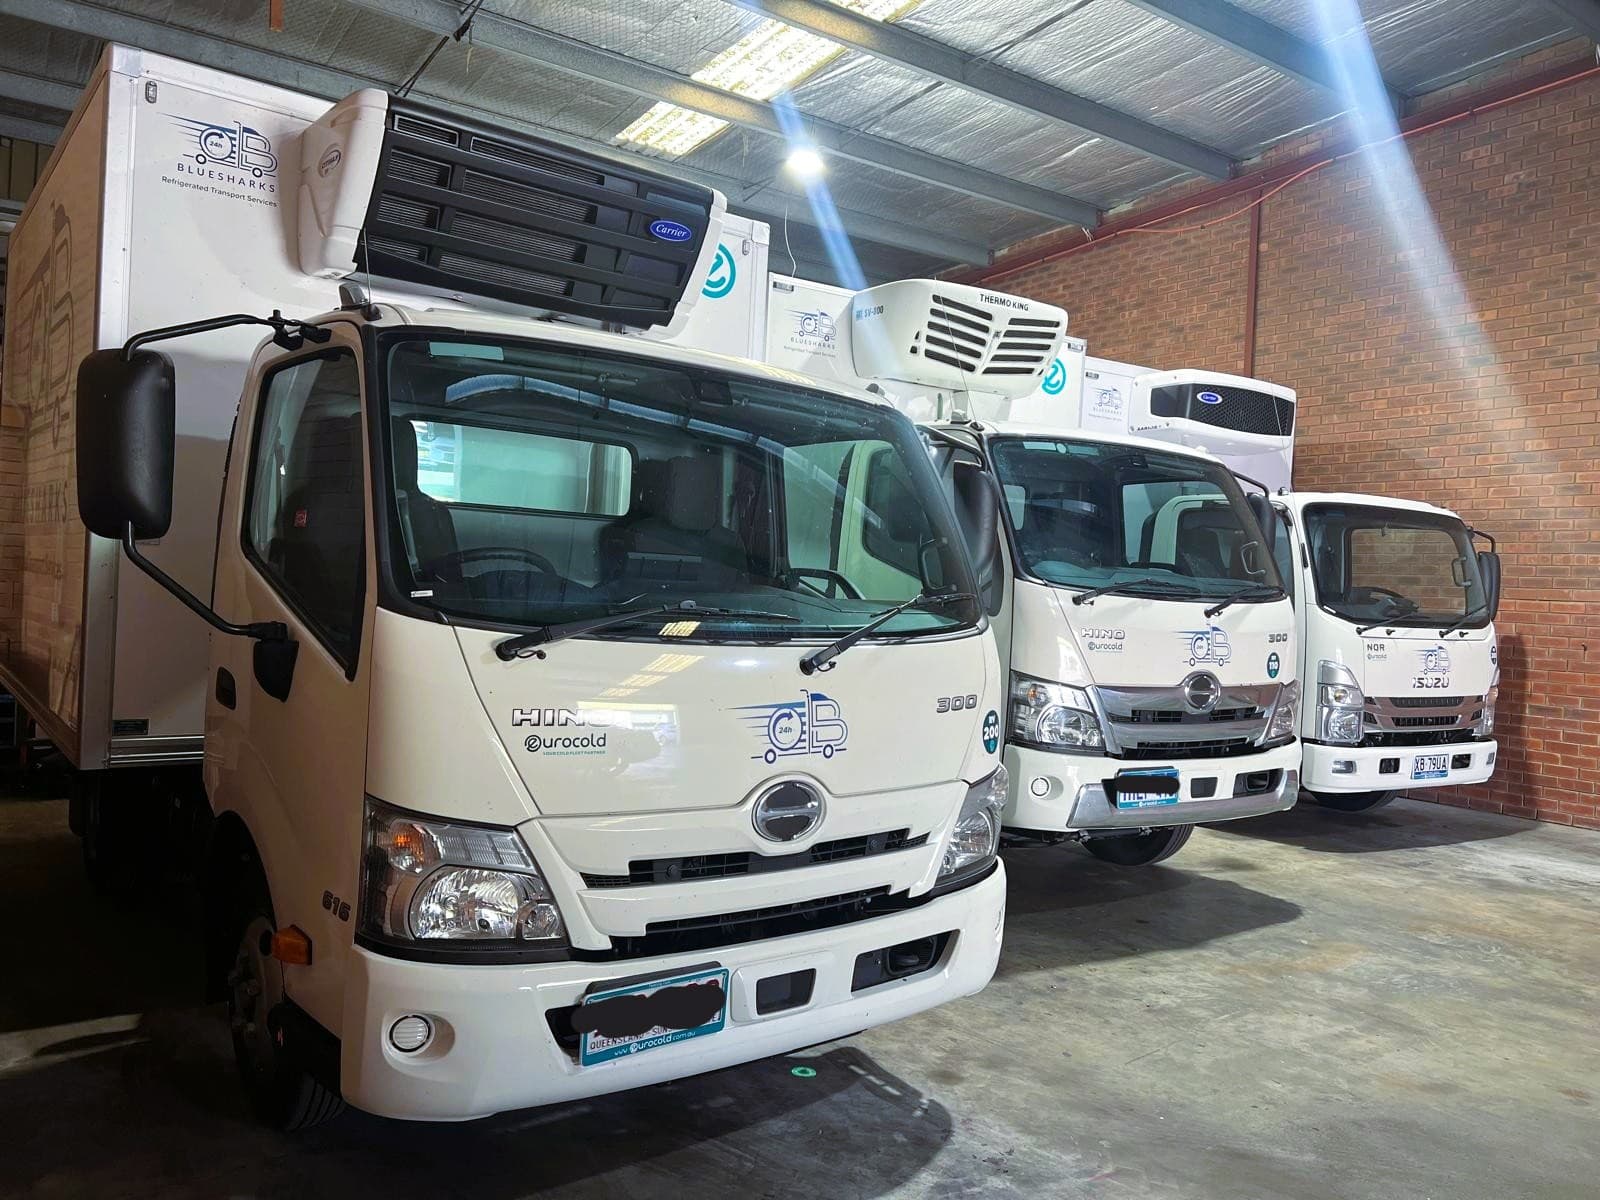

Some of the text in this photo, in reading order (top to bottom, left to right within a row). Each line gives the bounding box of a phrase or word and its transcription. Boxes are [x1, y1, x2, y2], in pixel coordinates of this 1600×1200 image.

[177, 163, 275, 193] BLUESHARKS
[161, 175, 278, 208] Refrigerated Transport Services
[656, 224, 688, 238] Carrier
[980, 293, 1029, 312] THERMO KING
[1081, 627, 1126, 640] HINO
[1268, 633, 1288, 643] 300
[1411, 677, 1450, 689] ISUZU
[936, 694, 978, 713] 300
[512, 708, 613, 727] HIN
[778, 726, 793, 735] 24h
[983, 724, 999, 741] 200
[322, 889, 351, 922] 616
